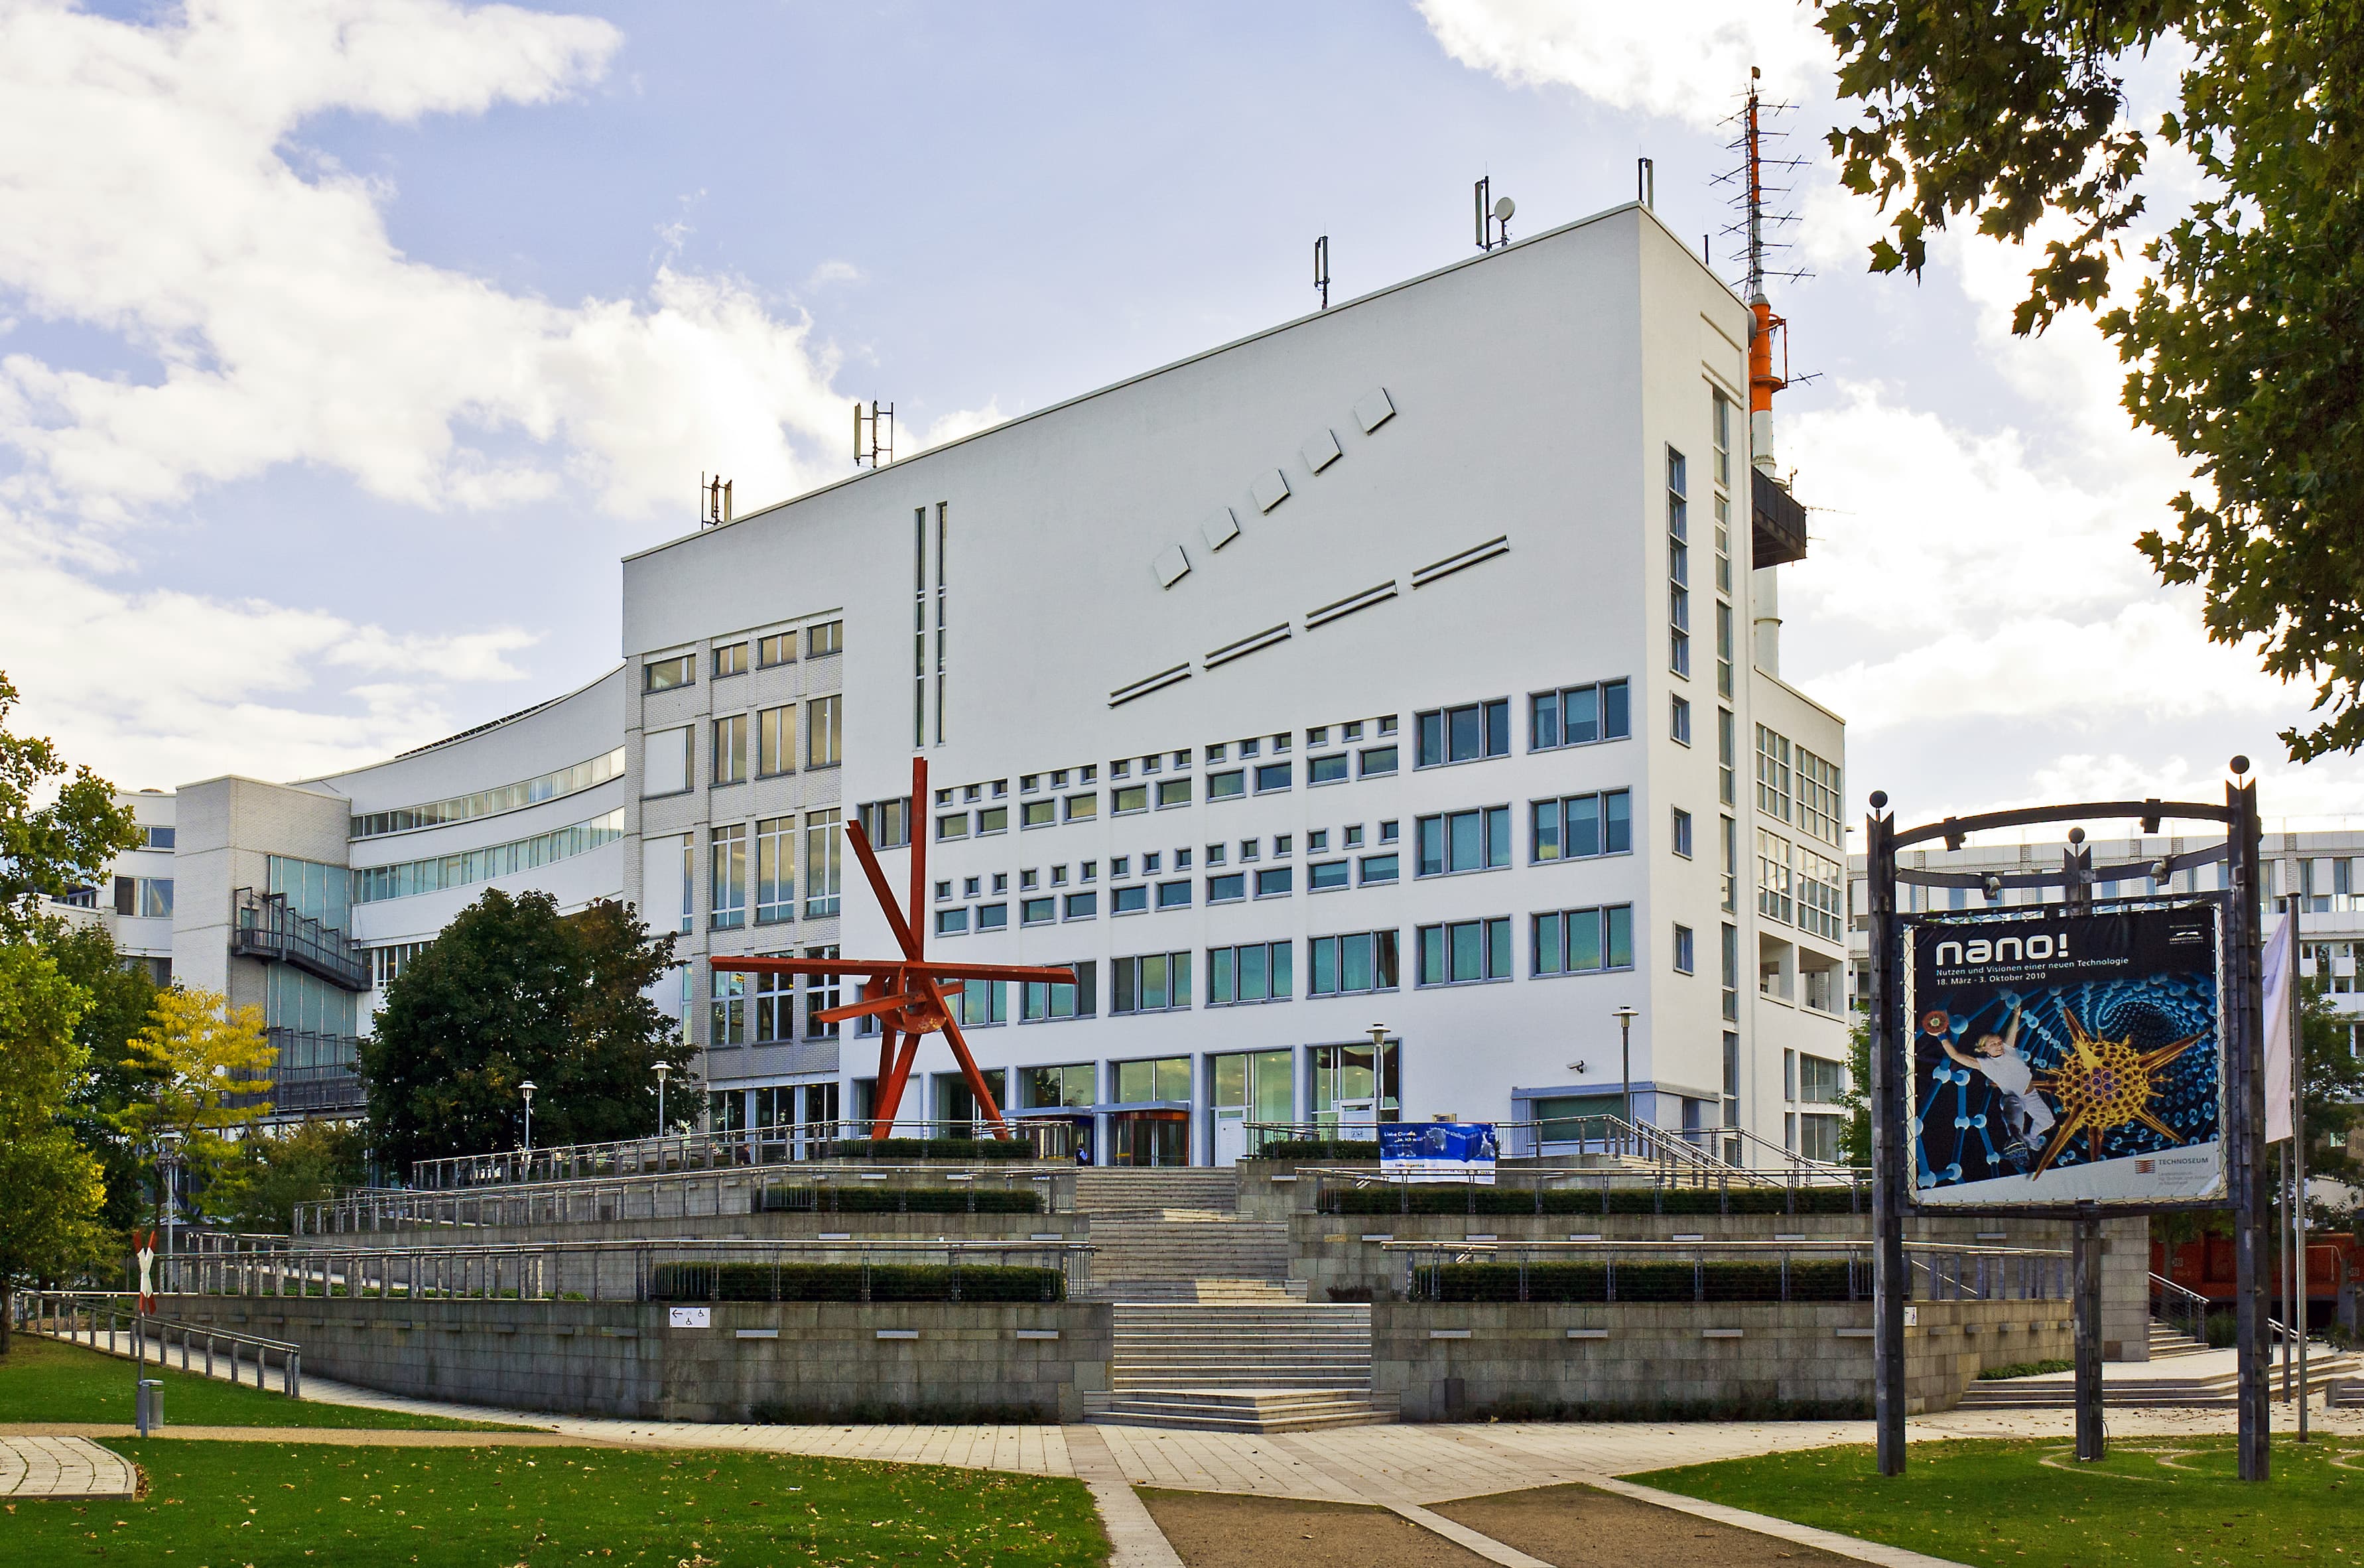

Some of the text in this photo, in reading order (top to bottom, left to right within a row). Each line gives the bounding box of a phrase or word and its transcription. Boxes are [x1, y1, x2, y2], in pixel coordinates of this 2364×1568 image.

[1936, 933, 2069, 966] nano!
[1987, 964, 2022, 973] Visionen
[2077, 956, 2129, 966] Technologie
[1951, 976, 1971, 985] März
[1989, 974, 2023, 982] Oktober
[2026, 972, 2046, 980] 2010
